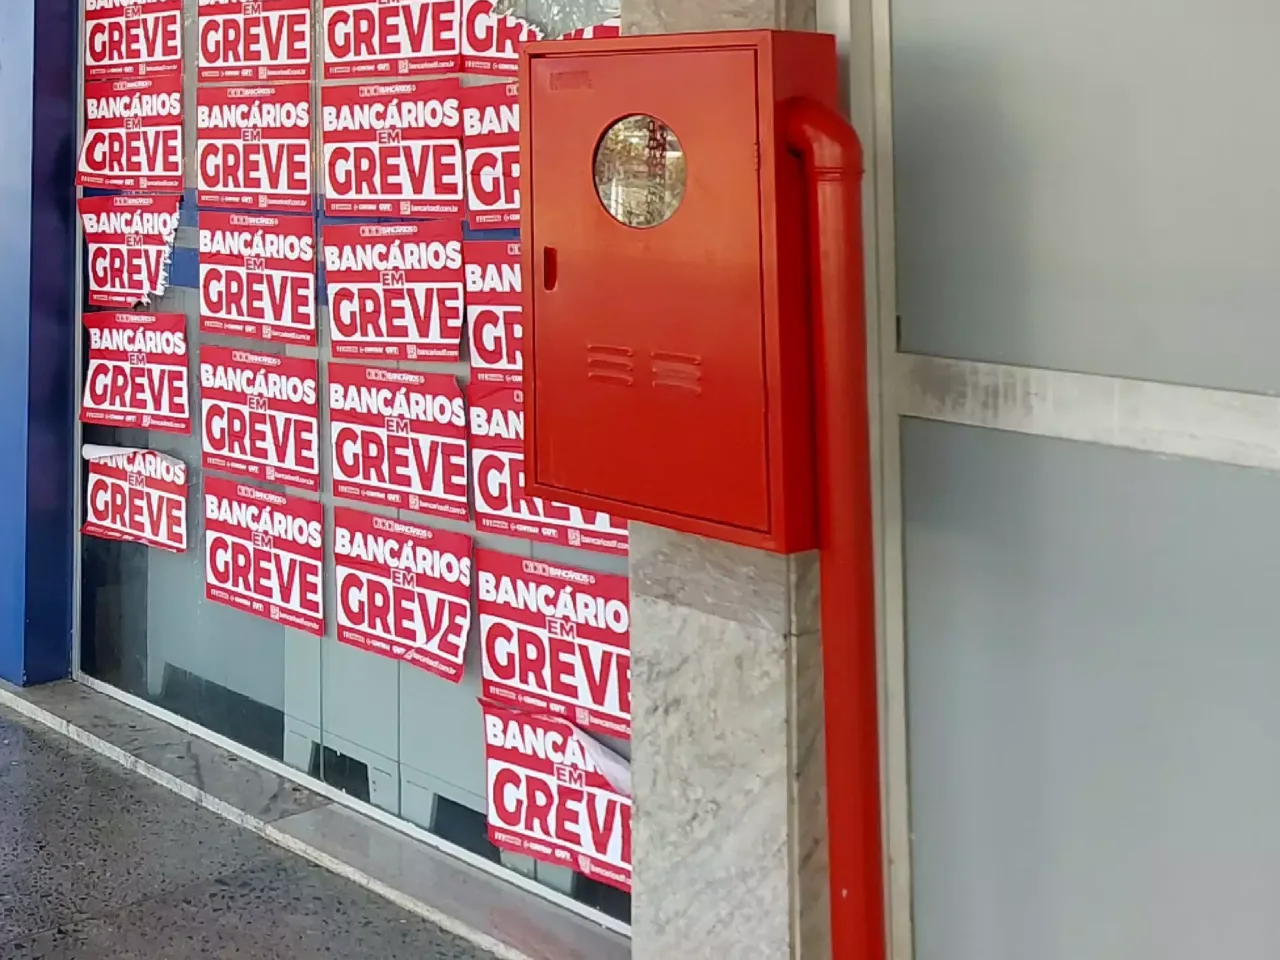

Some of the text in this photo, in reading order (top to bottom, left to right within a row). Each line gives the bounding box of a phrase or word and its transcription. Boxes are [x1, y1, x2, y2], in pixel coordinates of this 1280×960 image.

[125, 6, 141, 18] EM
[243, 2, 262, 16] EM
[88, 14, 178, 62] GREVE
[200, 14, 307, 64] GREVE
[327, 0, 457, 59] GREVE
[87, 91, 181, 119] BANCÁRIOS
[198, 100, 309, 129] BANCÁRIOS
[324, 99, 459, 132] BANCÁRIOS
[125, 119, 142, 130] EM
[242, 129, 261, 142] EM
[377, 130, 401, 144] EM
[85, 130, 178, 172] GREVE
[200, 143, 307, 189] GREVE
[328, 145, 459, 197] GREVE
[125, 235, 142, 247] EM
[199, 230, 313, 260] BANCÁRIOS
[324, 240, 461, 271] BANCÁRIOS
[91, 246, 163, 292] GREV
[245, 258, 264, 271] EM
[380, 271, 405, 286] EM
[202, 268, 311, 325] GREVE
[332, 287, 460, 339] GREVE
[90, 326, 185, 355] BANCÁRIOS
[129, 353, 146, 365] EM
[89, 363, 185, 414] GREVE
[200, 364, 316, 404] BANCÁRIOS
[247, 396, 267, 411] EM
[330, 383, 466, 427] BANCÁRIOS
[205, 403, 314, 470] GREVE
[385, 418, 410, 434] EM
[336, 427, 465, 499] GREVE
[128, 473, 145, 488] EM
[90, 479, 183, 544] GREVE
[205, 494, 322, 548] BANCÁRIOS
[252, 532, 273, 548] EM
[335, 526, 470, 587] BANCÁRIOS
[209, 537, 319, 615] GREVE
[391, 568, 416, 589] EM
[340, 572, 467, 658] GREVE
[479, 570, 628, 634] BANCÁRIO
[546, 617, 576, 639] EM
[555, 765, 585, 788] EM
